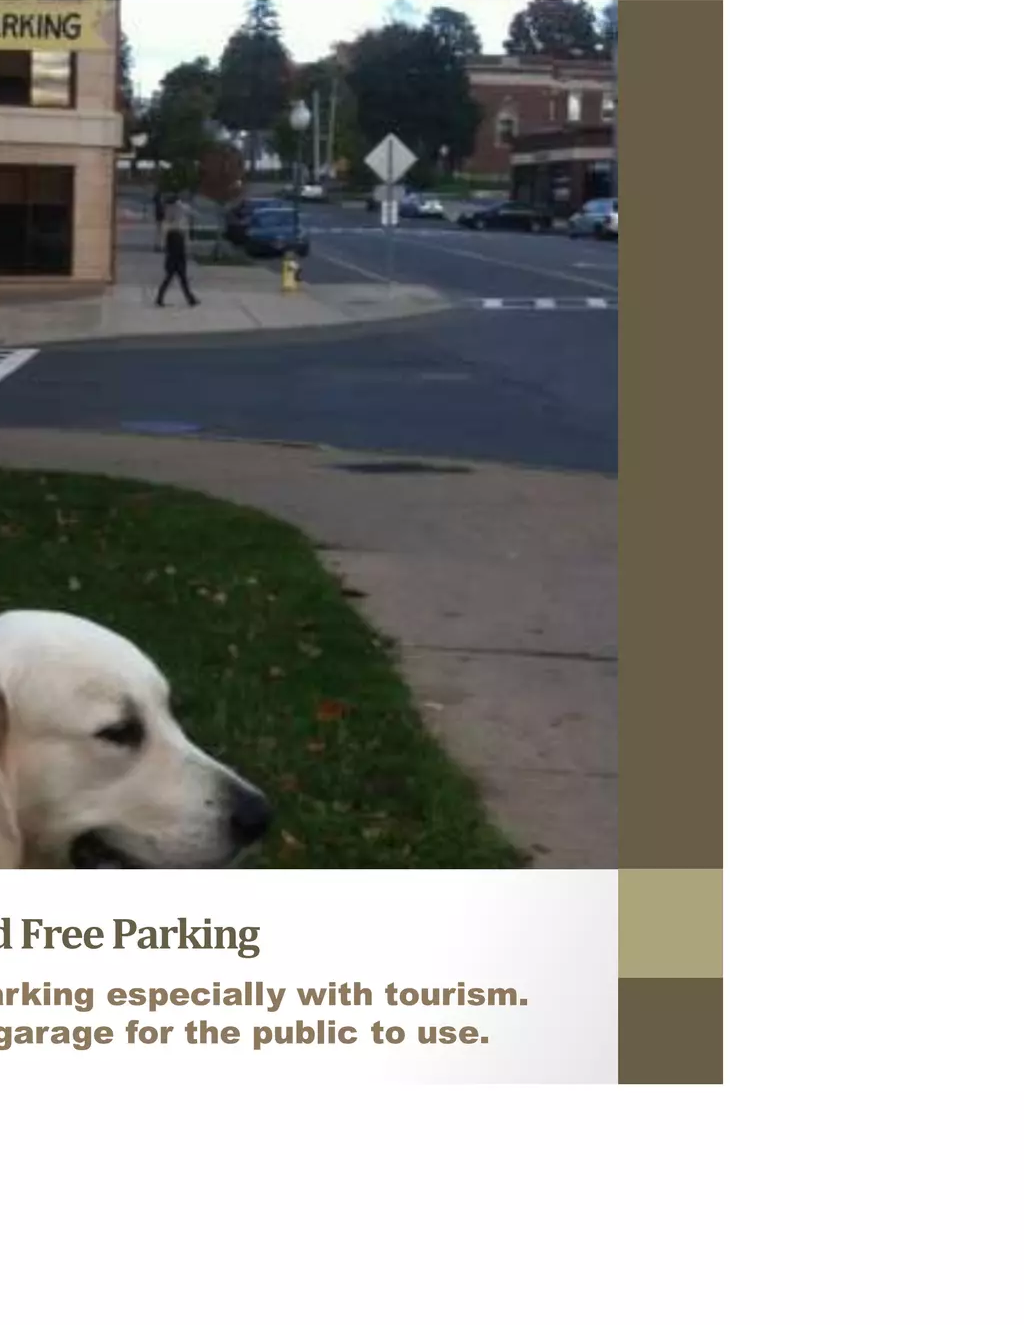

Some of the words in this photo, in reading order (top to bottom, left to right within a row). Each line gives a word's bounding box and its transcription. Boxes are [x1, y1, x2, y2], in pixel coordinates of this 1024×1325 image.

[22, 918, 104, 950] Free
[113, 918, 260, 958] Parking
[107, 982, 286, 1012] especially
[297, 982, 372, 1006] with
[385, 982, 527, 1006] tourism.
[126, 1020, 174, 1044] for
[185, 1020, 240, 1044] the
[254, 1020, 357, 1050] public
[371, 1021, 405, 1044] to
[418, 1026, 488, 1044] use.
